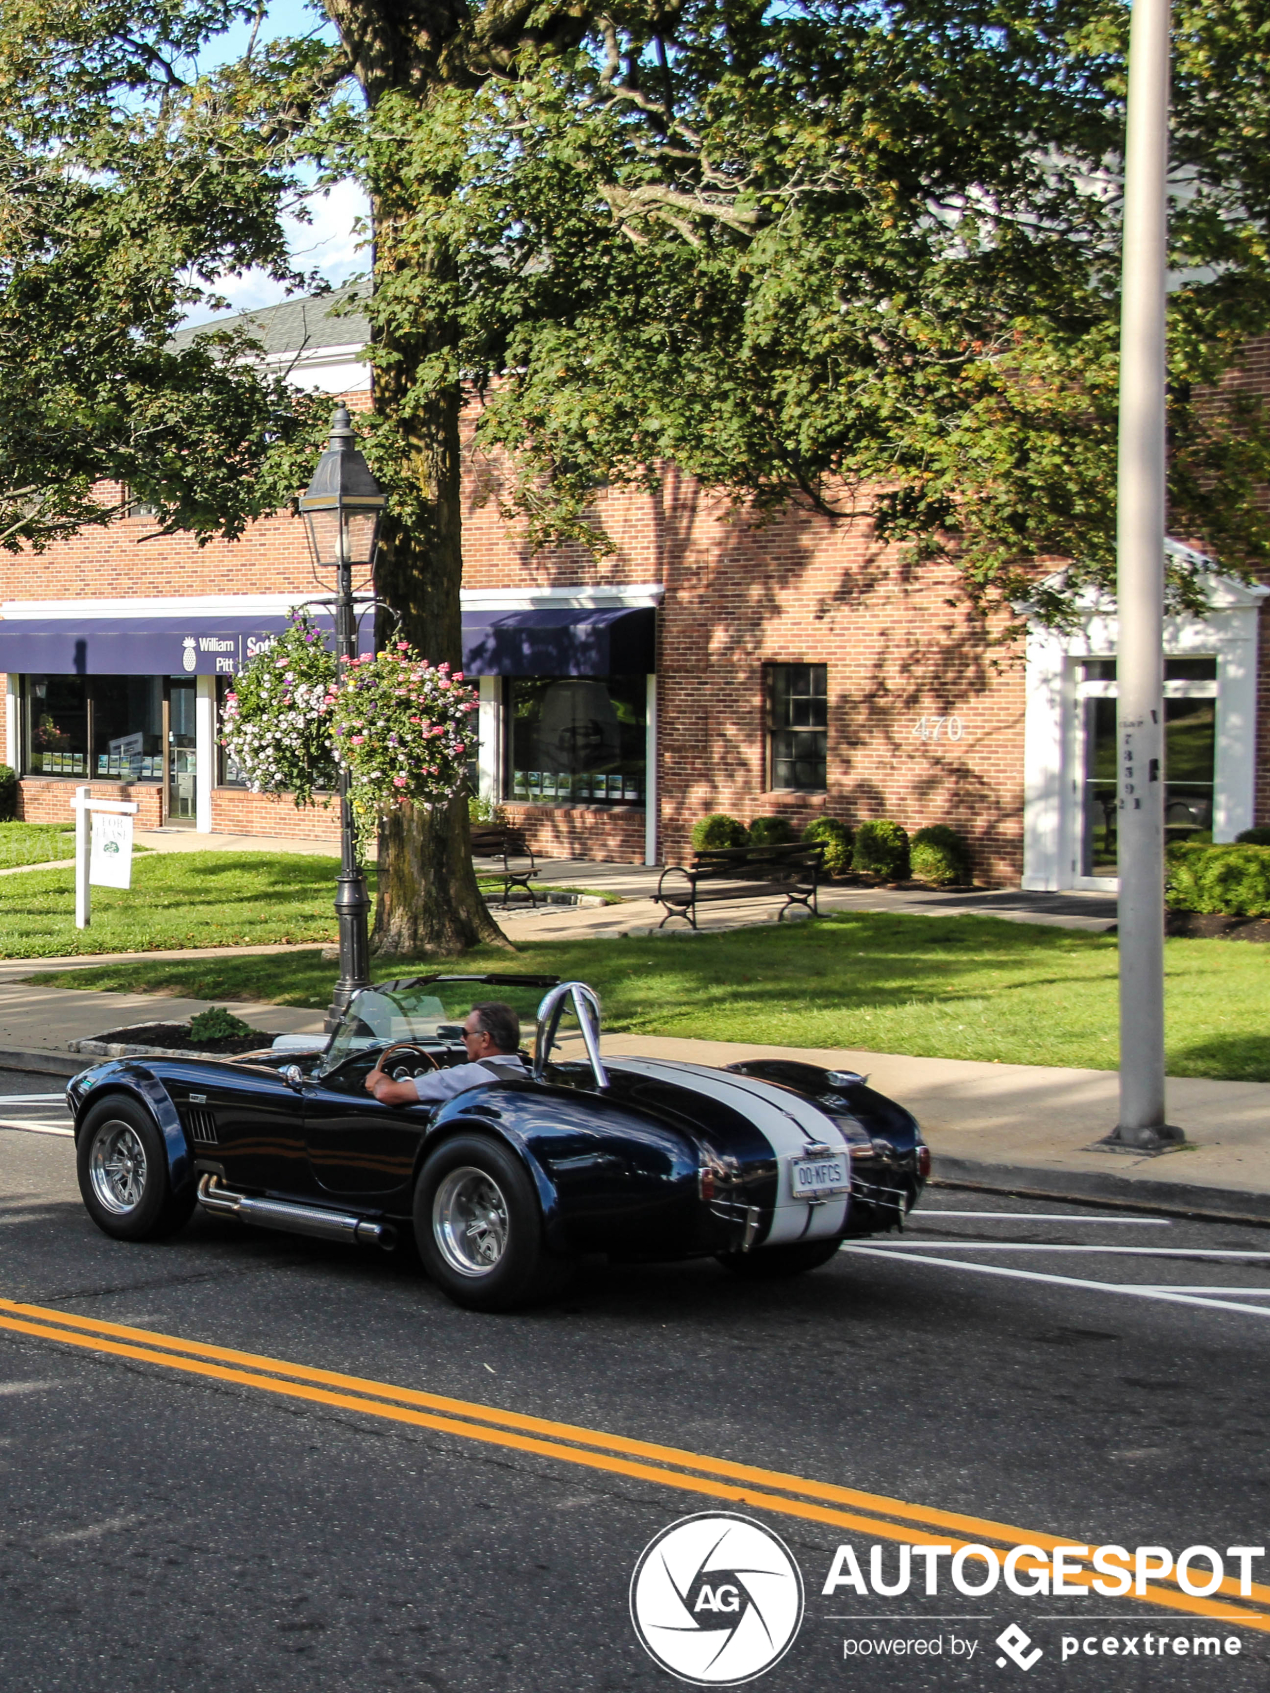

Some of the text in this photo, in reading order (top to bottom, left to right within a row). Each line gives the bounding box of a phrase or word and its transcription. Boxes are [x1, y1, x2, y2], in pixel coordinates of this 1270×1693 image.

[198, 637, 234, 652] William
[215, 657, 234, 672] Pitt
[911, 716, 962, 742] 470
[102, 816, 123, 829] FOR
